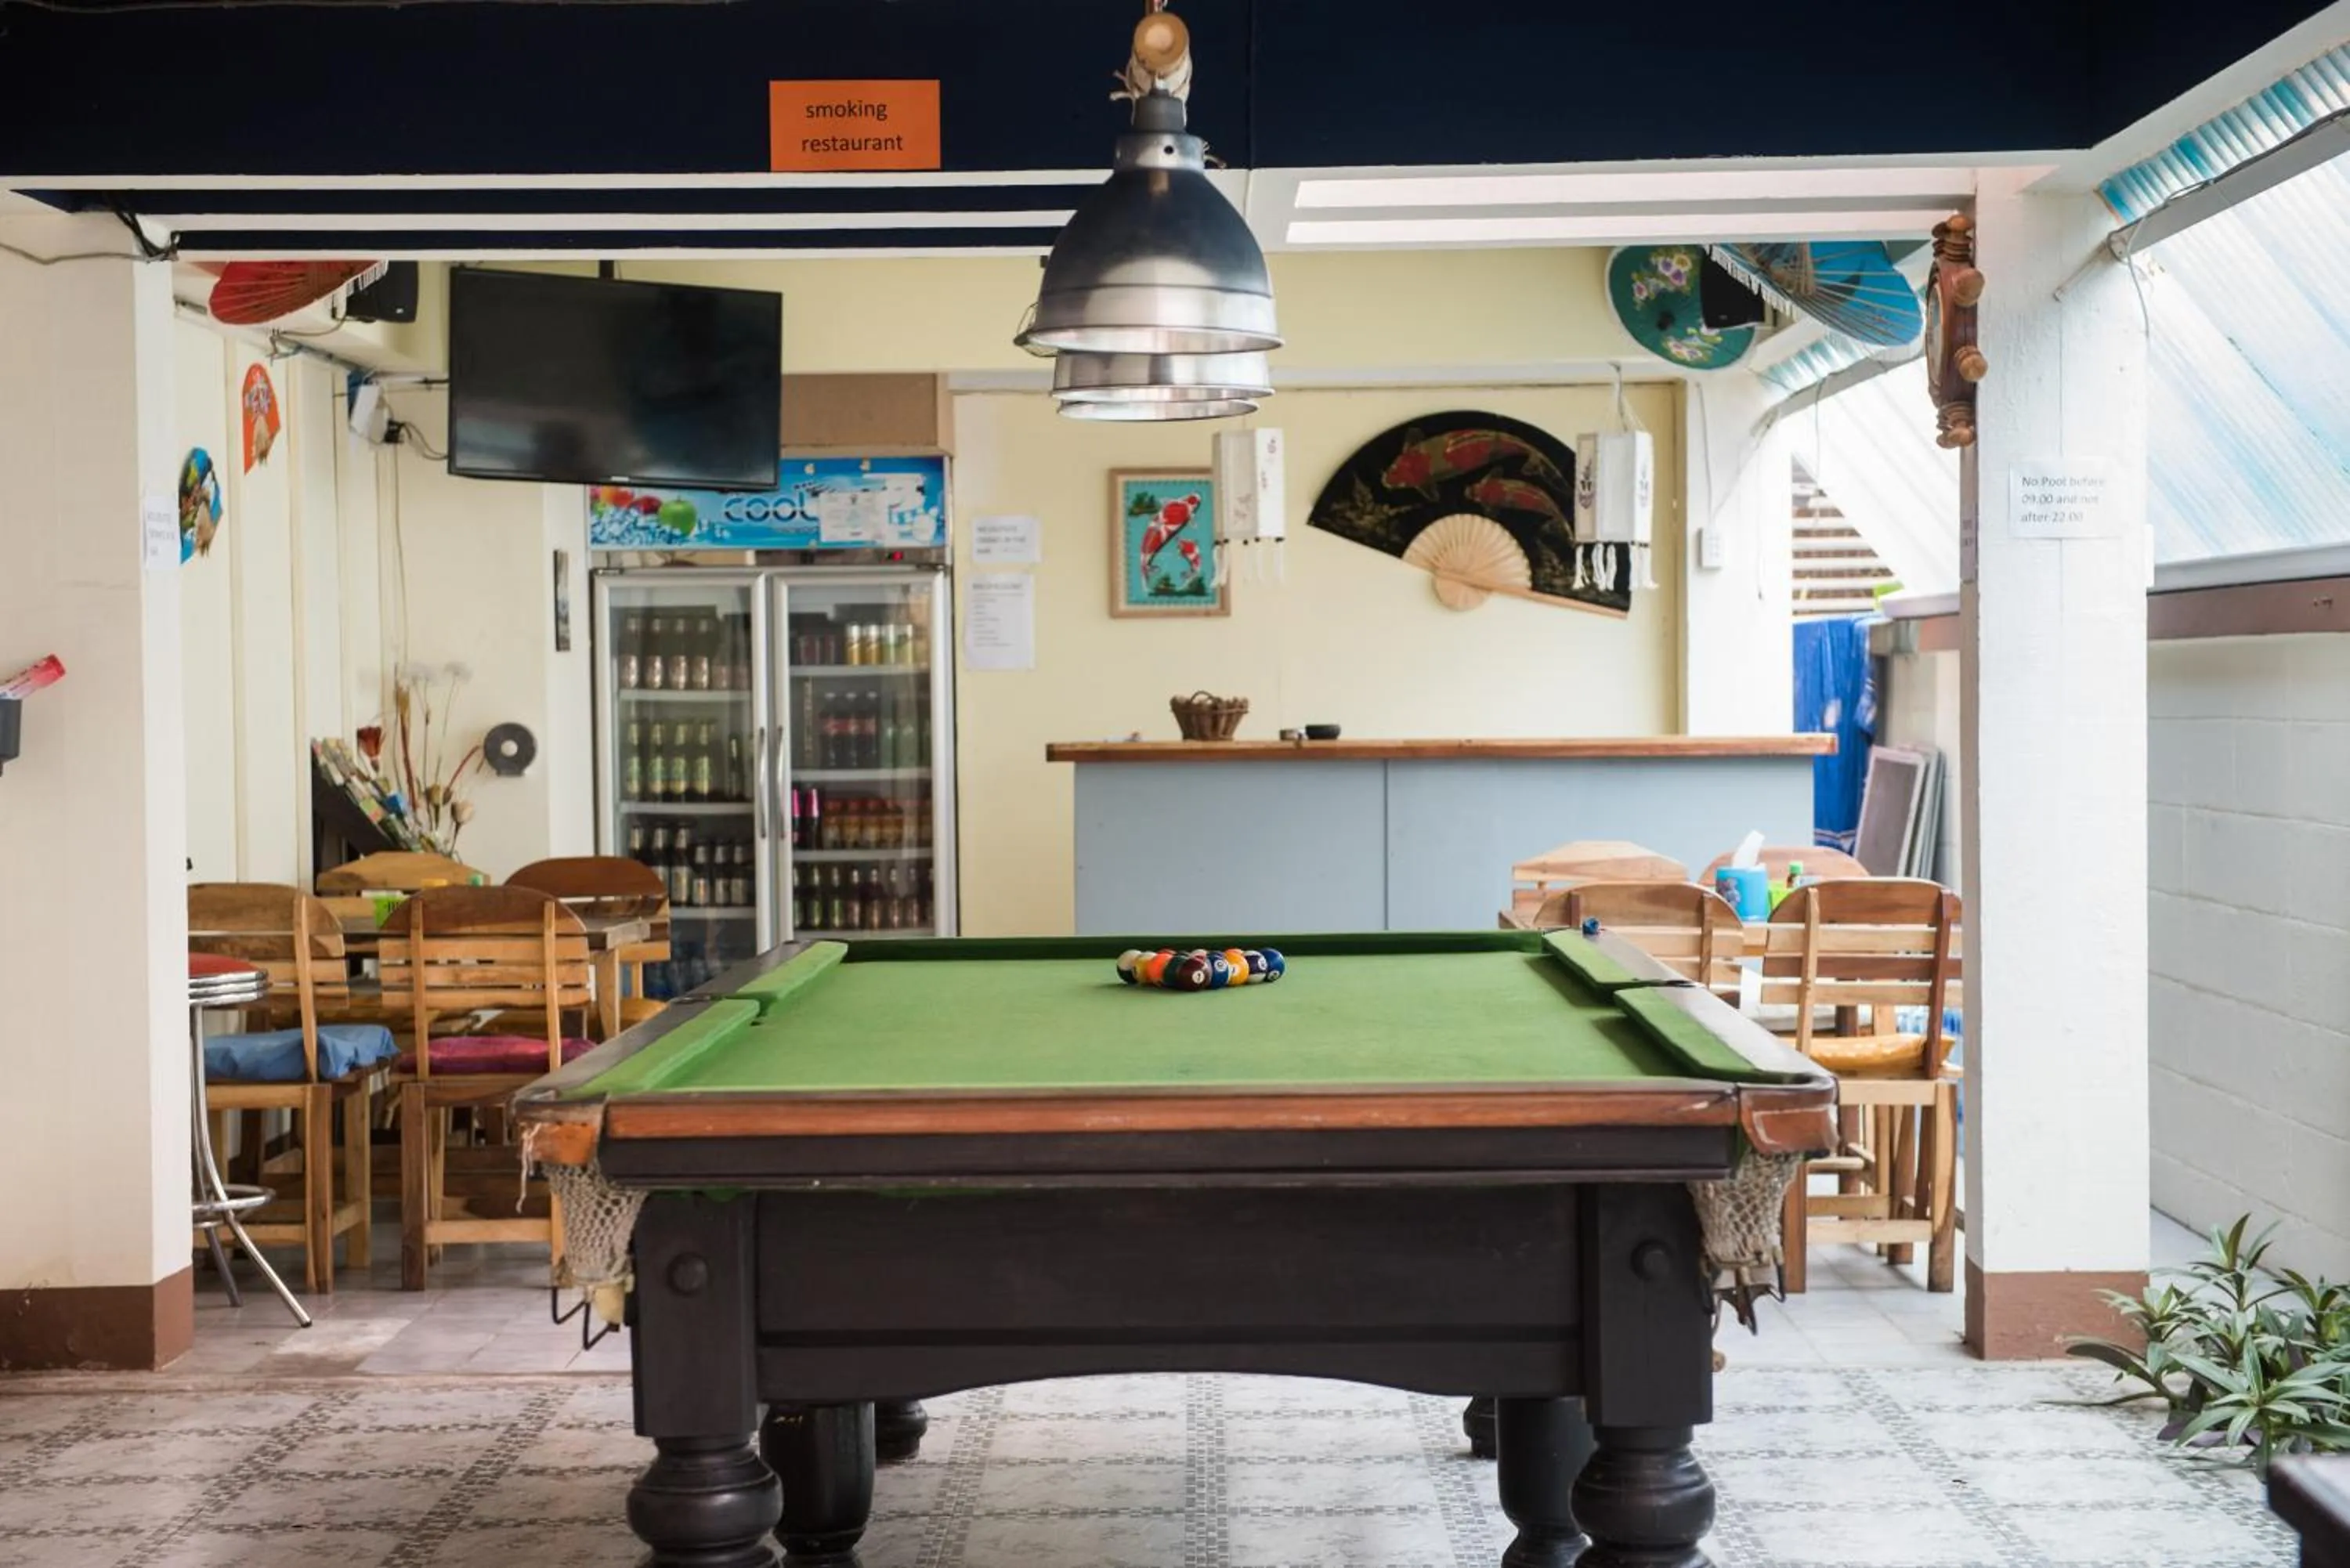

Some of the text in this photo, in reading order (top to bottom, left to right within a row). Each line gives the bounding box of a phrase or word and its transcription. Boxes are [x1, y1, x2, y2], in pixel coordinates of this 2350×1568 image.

[805, 99, 888, 121] smoking
[801, 135, 903, 153] restaurant
[2022, 476, 2038, 487] No
[2041, 476, 2066, 487] Pool
[2020, 511, 2048, 522] after
